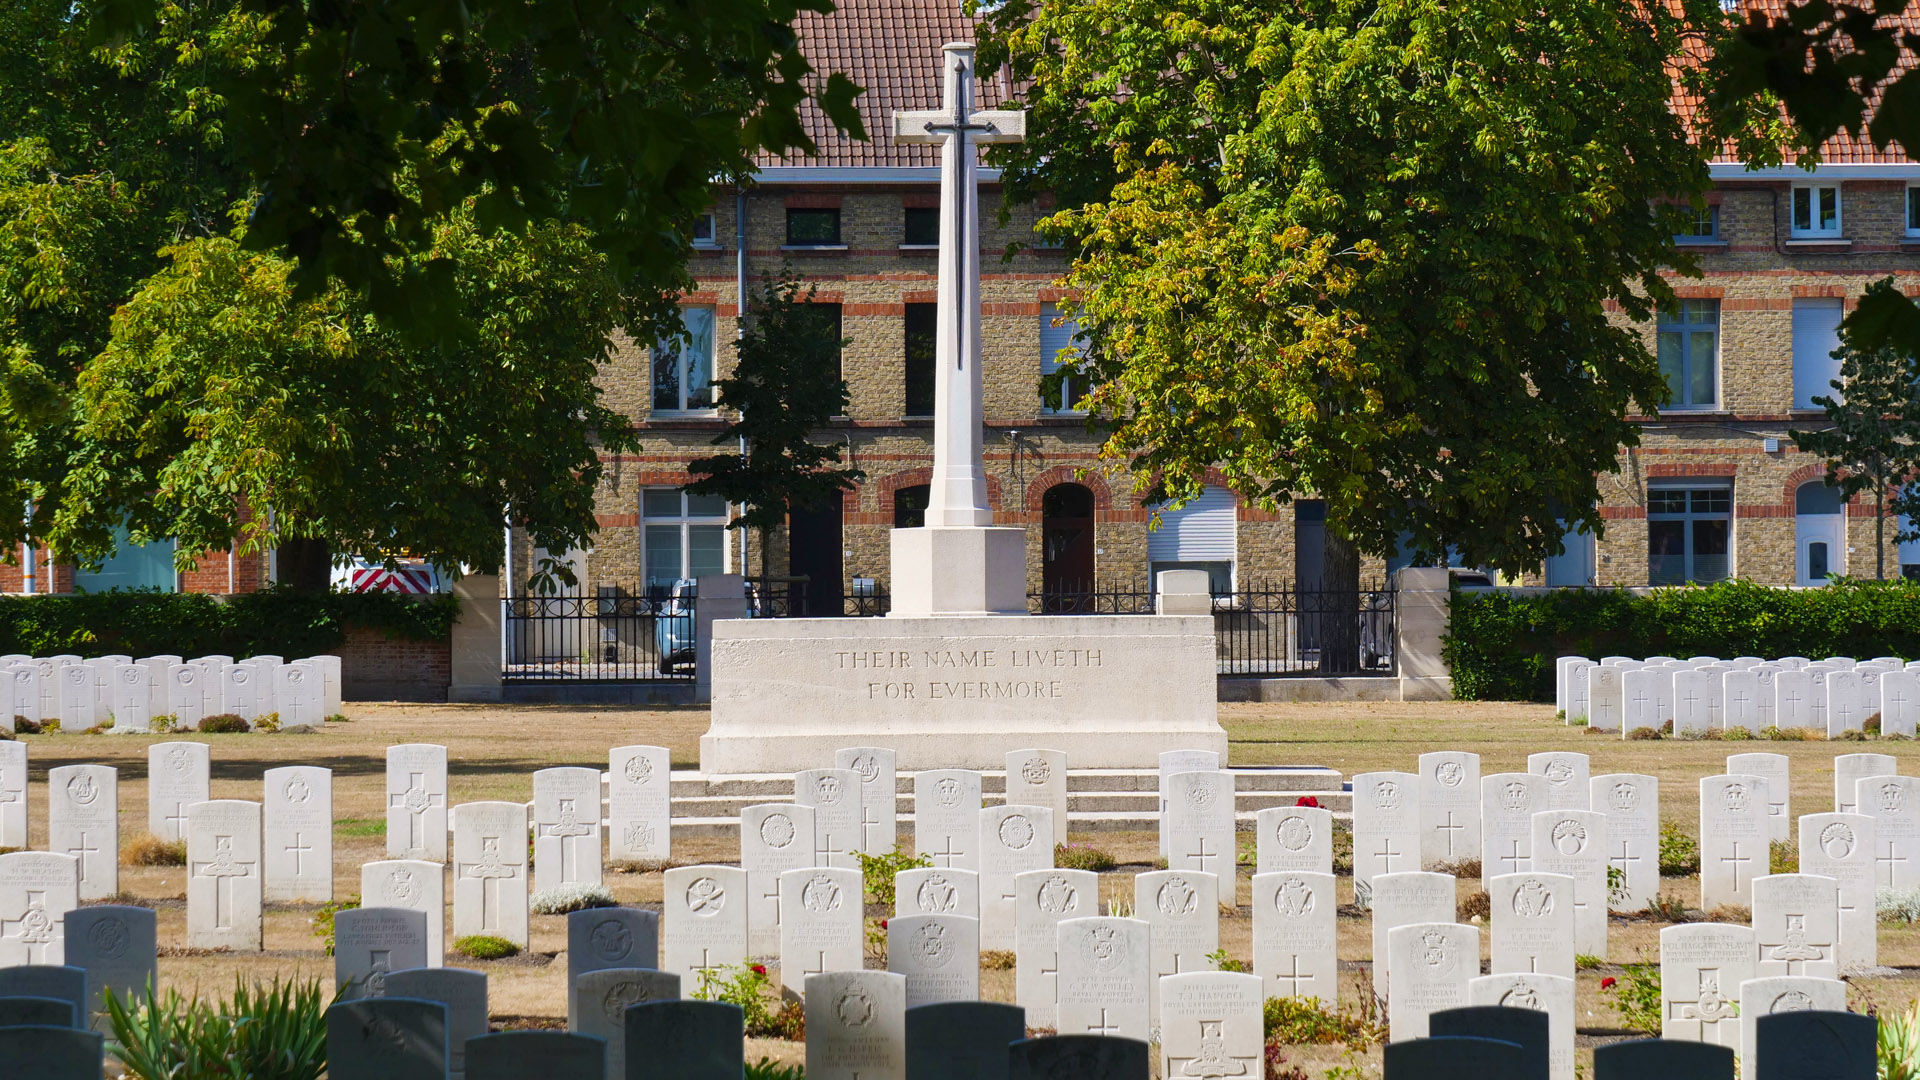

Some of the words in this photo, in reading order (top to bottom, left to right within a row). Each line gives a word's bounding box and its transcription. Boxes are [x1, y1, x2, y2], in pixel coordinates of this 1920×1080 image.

[835, 650, 914, 669] THEIR
[924, 650, 996, 669] NAME
[1012, 650, 1104, 669] LIVETH
[868, 681, 915, 699] FOR
[929, 681, 1063, 699] EVERMORE
